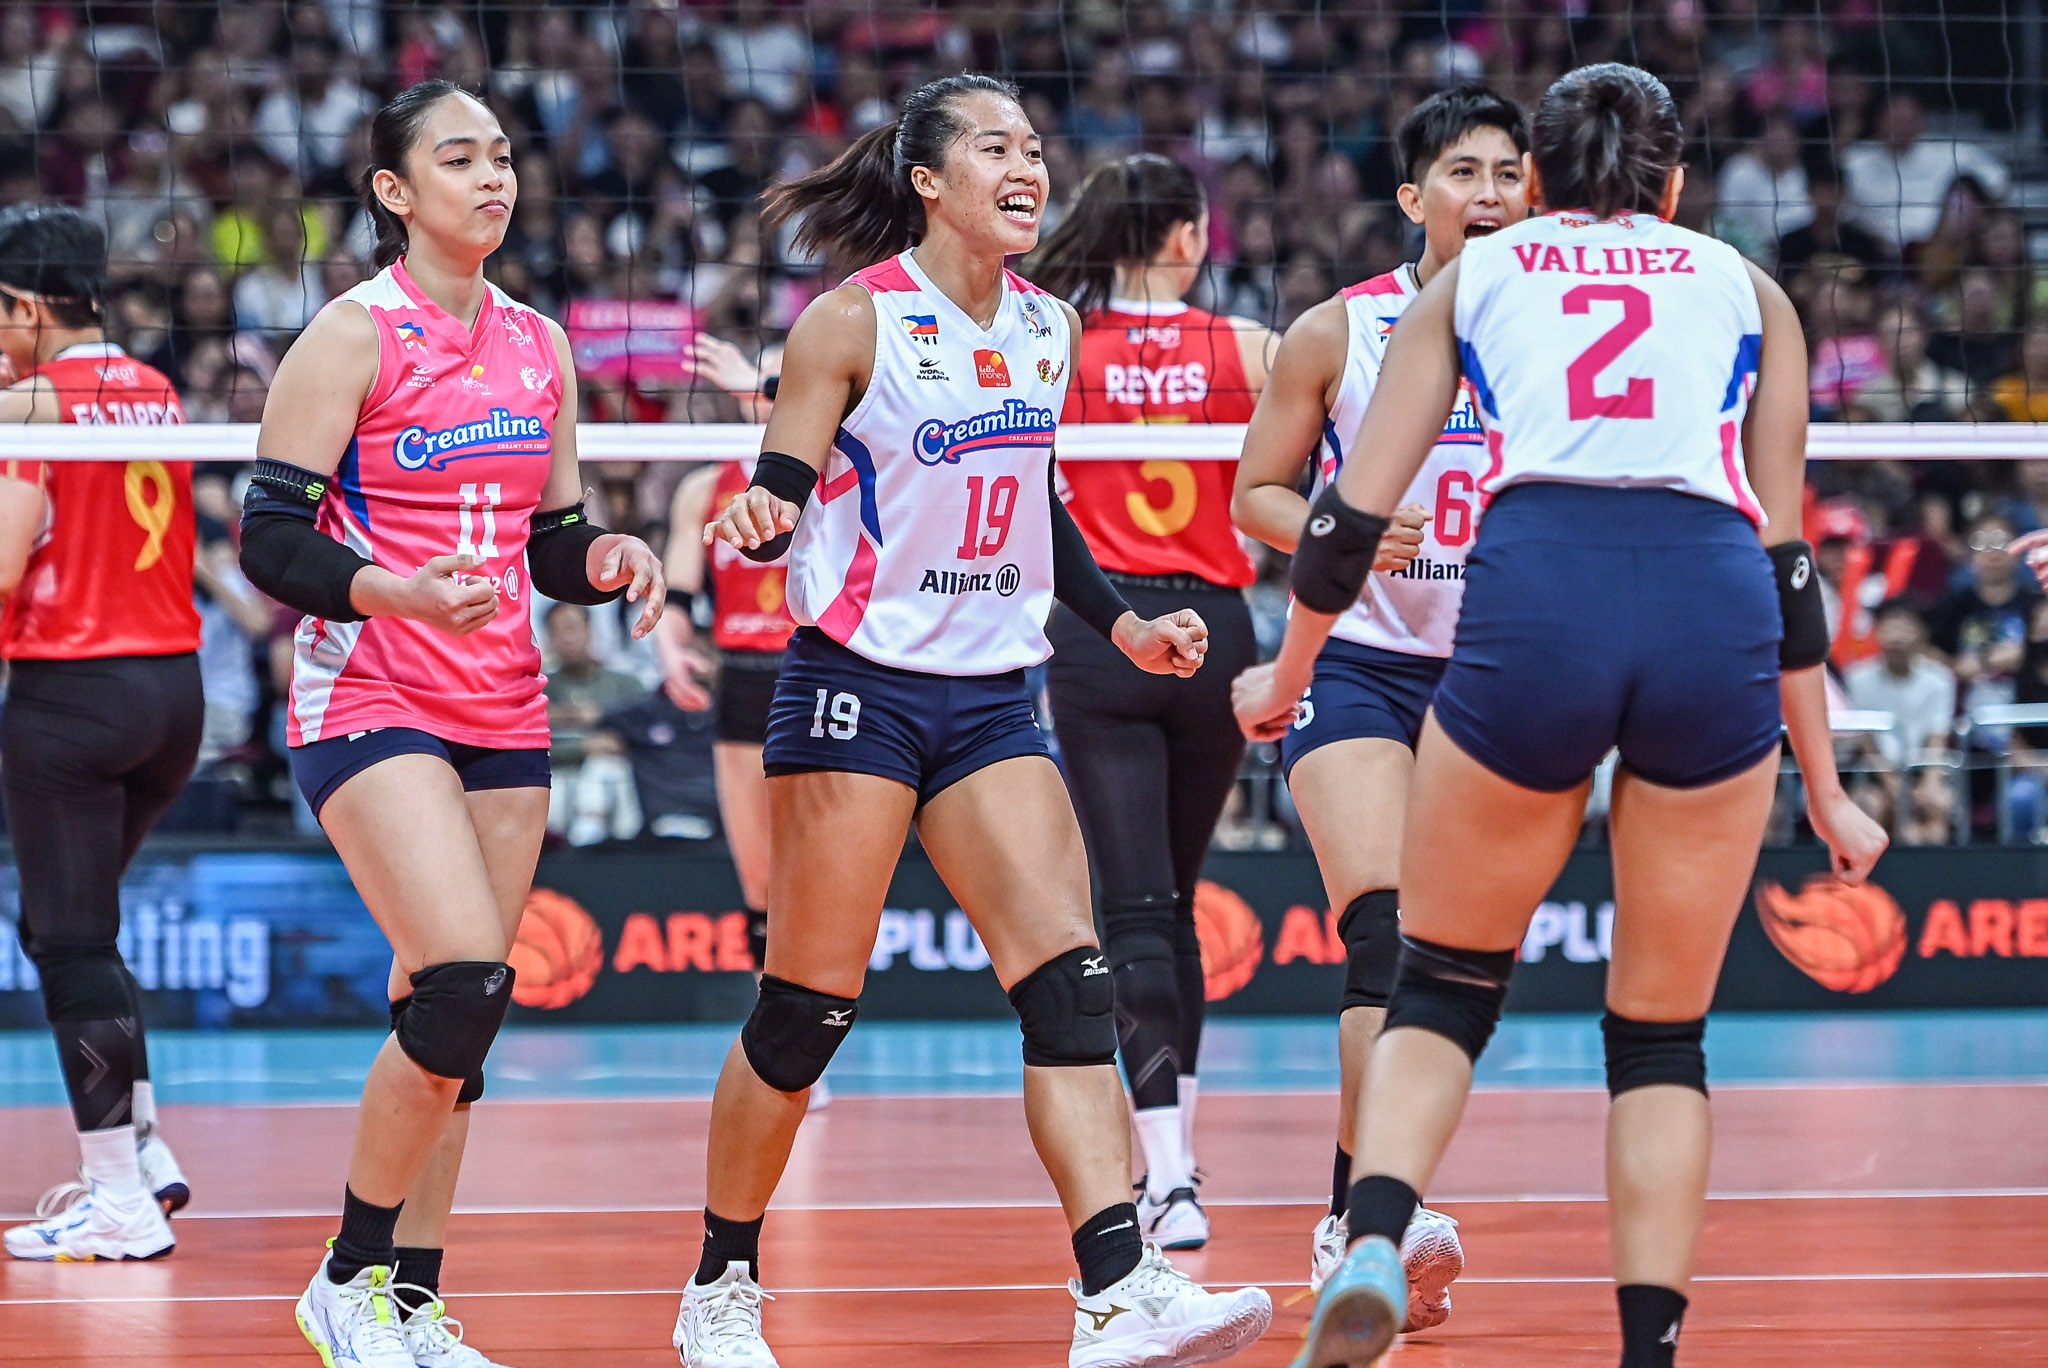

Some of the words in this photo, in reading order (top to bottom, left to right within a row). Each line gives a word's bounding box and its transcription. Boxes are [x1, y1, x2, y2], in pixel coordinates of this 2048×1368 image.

[1512, 243, 1696, 276] VALDEZ
[979, 364, 996, 373] hello
[980, 372, 1007, 382] money
[1561, 284, 1654, 421] 2
[1105, 361, 1209, 405] REYES
[395, 409, 541, 469] Creamline
[916, 401, 1053, 464] Creamline
[457, 482, 501, 558] 11
[956, 475, 1020, 560] 19
[1434, 469, 1474, 547] 6
[810, 688, 861, 740] 19
